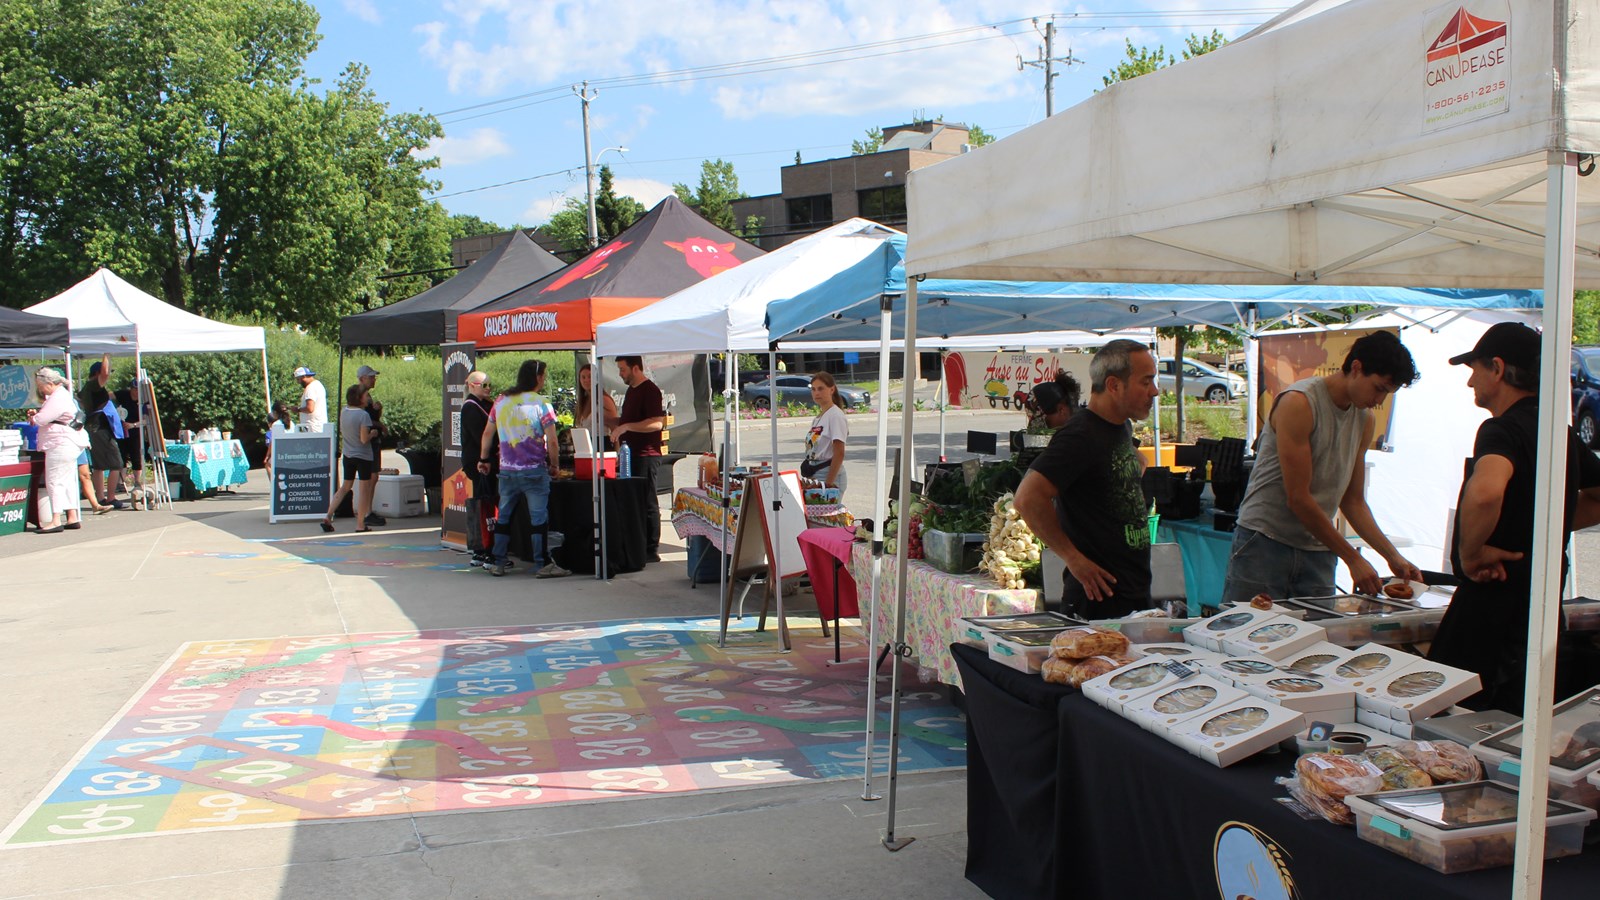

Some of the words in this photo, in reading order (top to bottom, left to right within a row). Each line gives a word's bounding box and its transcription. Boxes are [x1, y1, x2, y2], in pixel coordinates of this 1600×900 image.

[1427, 80, 1506, 112] 1-800-561-2235
[484, 313, 510, 338] SAUCES
[984, 354, 1012, 381] Anse
[1015, 365, 1030, 381] au
[1033, 356, 1061, 384] Sabl
[1011, 355, 1032, 364] FERME
[253, 687, 321, 705] 53
[455, 677, 518, 695] 37
[150, 692, 220, 712] 60
[132, 714, 206, 733] 61
[567, 712, 637, 734] 30
[576, 737, 651, 759] 31
[461, 773, 543, 804] 33
[586, 764, 670, 794] 32
[47, 803, 145, 835] 64
